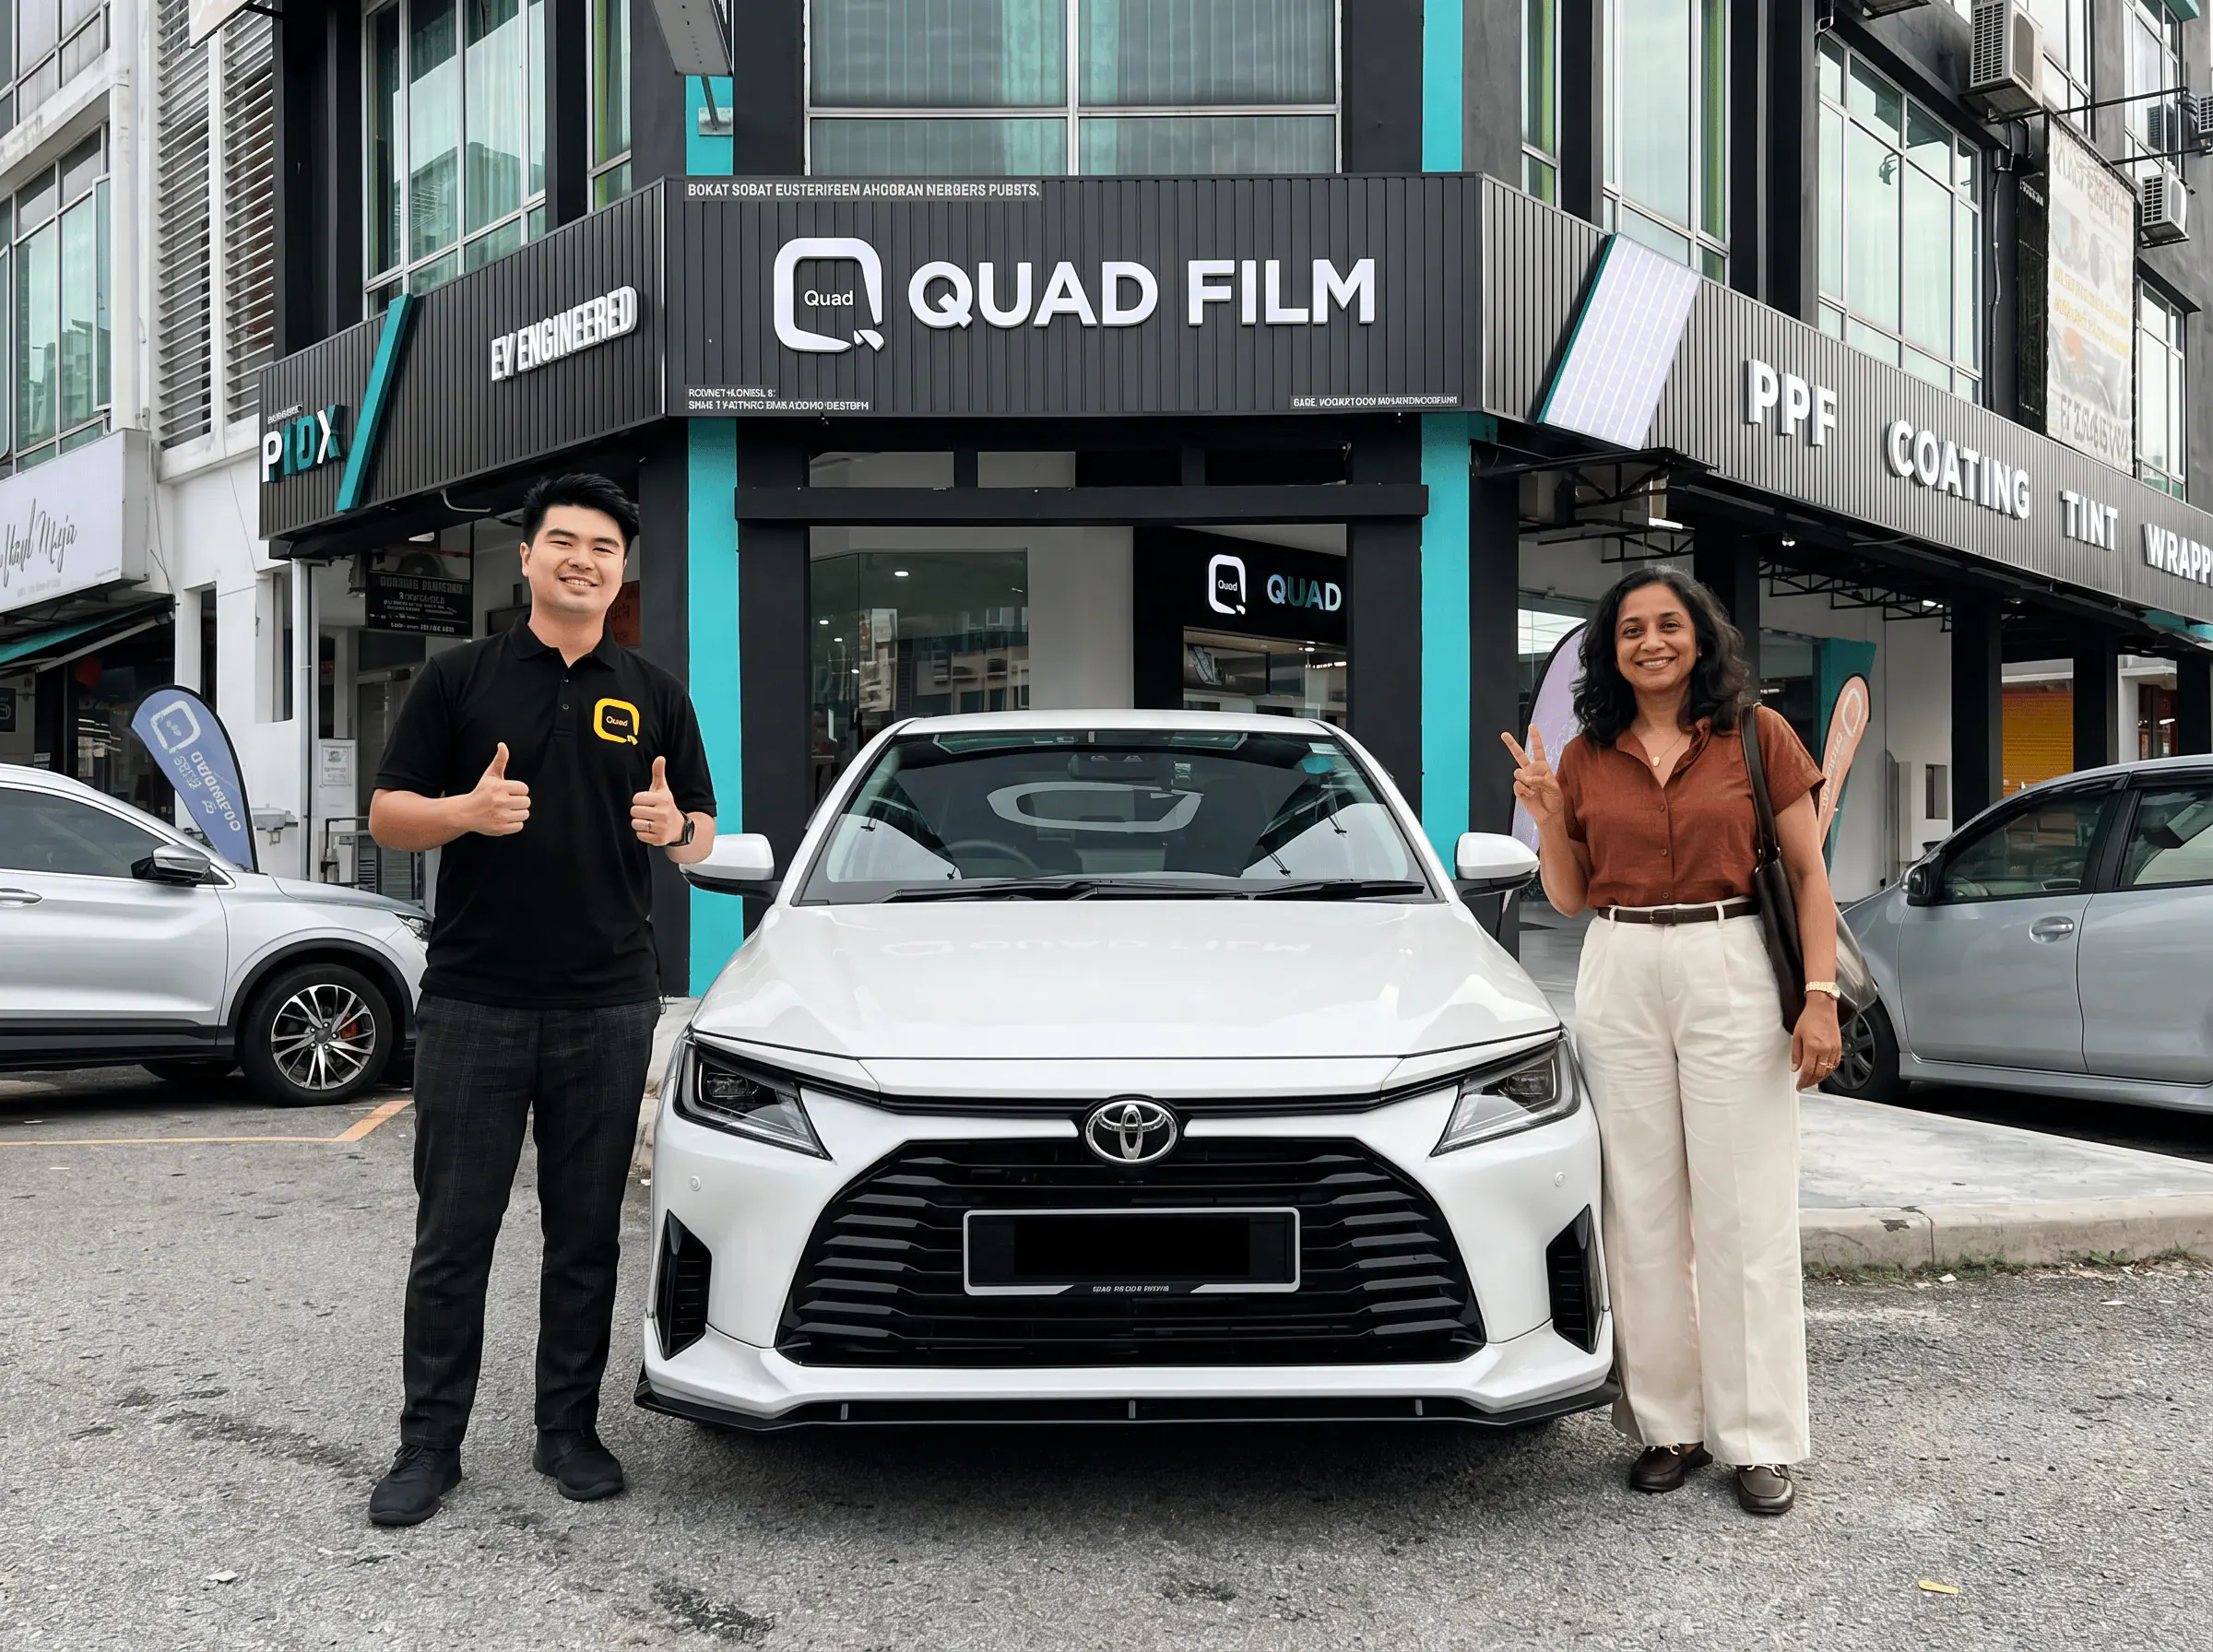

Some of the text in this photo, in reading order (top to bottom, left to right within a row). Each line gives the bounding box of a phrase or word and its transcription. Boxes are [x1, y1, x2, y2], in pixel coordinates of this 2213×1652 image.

[688, 183, 728, 196] BOKAT
[732, 183, 773, 196] SOBAT
[804, 289, 854, 306] Quad
[908, 258, 1376, 329] QUAD FILM
[517, 286, 637, 372] ENGINEERED
[1747, 359, 1837, 446] PPF
[1888, 419, 2030, 519] COATING
[2061, 490, 2118, 551] TINT
[2142, 523, 2213, 587] WRAPP
[1267, 573, 1342, 611] QUAD
